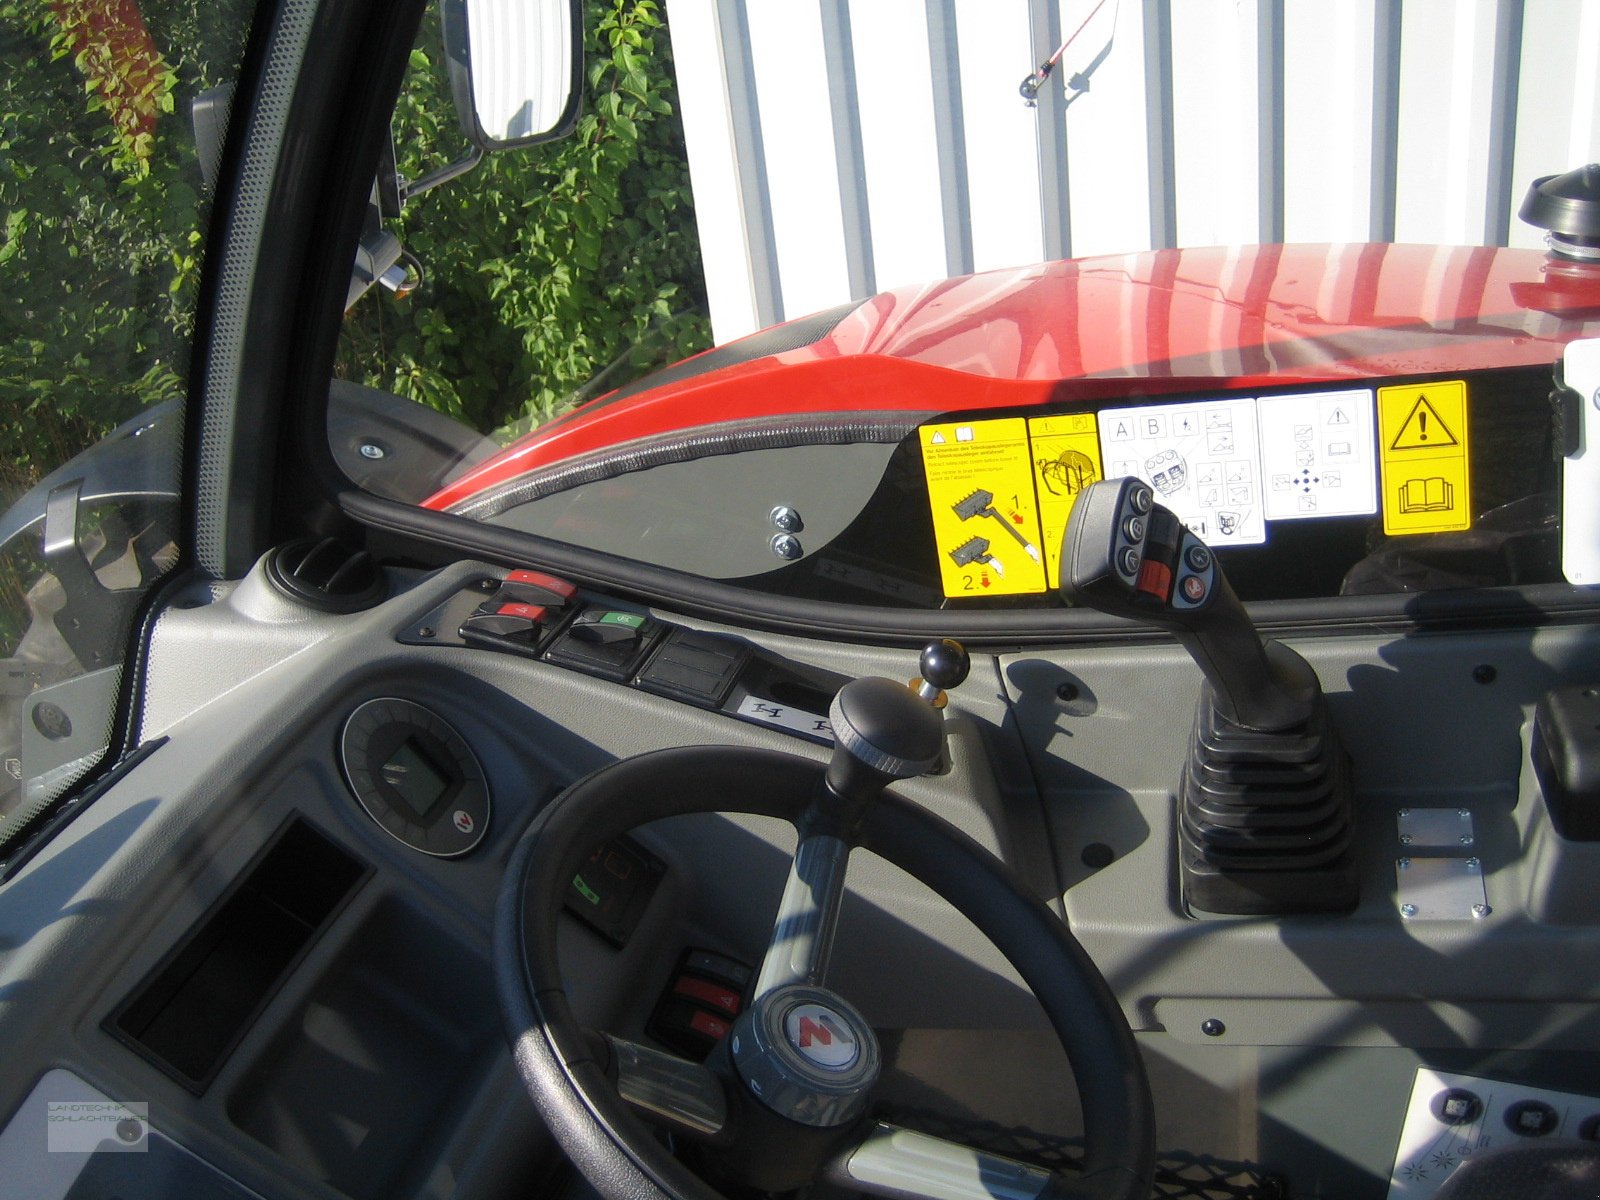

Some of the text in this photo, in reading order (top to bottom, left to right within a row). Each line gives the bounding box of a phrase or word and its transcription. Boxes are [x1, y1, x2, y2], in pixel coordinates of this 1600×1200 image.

[1116, 419, 1160, 436] A B
[1012, 494, 1027, 510] 1.
[963, 576, 979, 590] 2.
